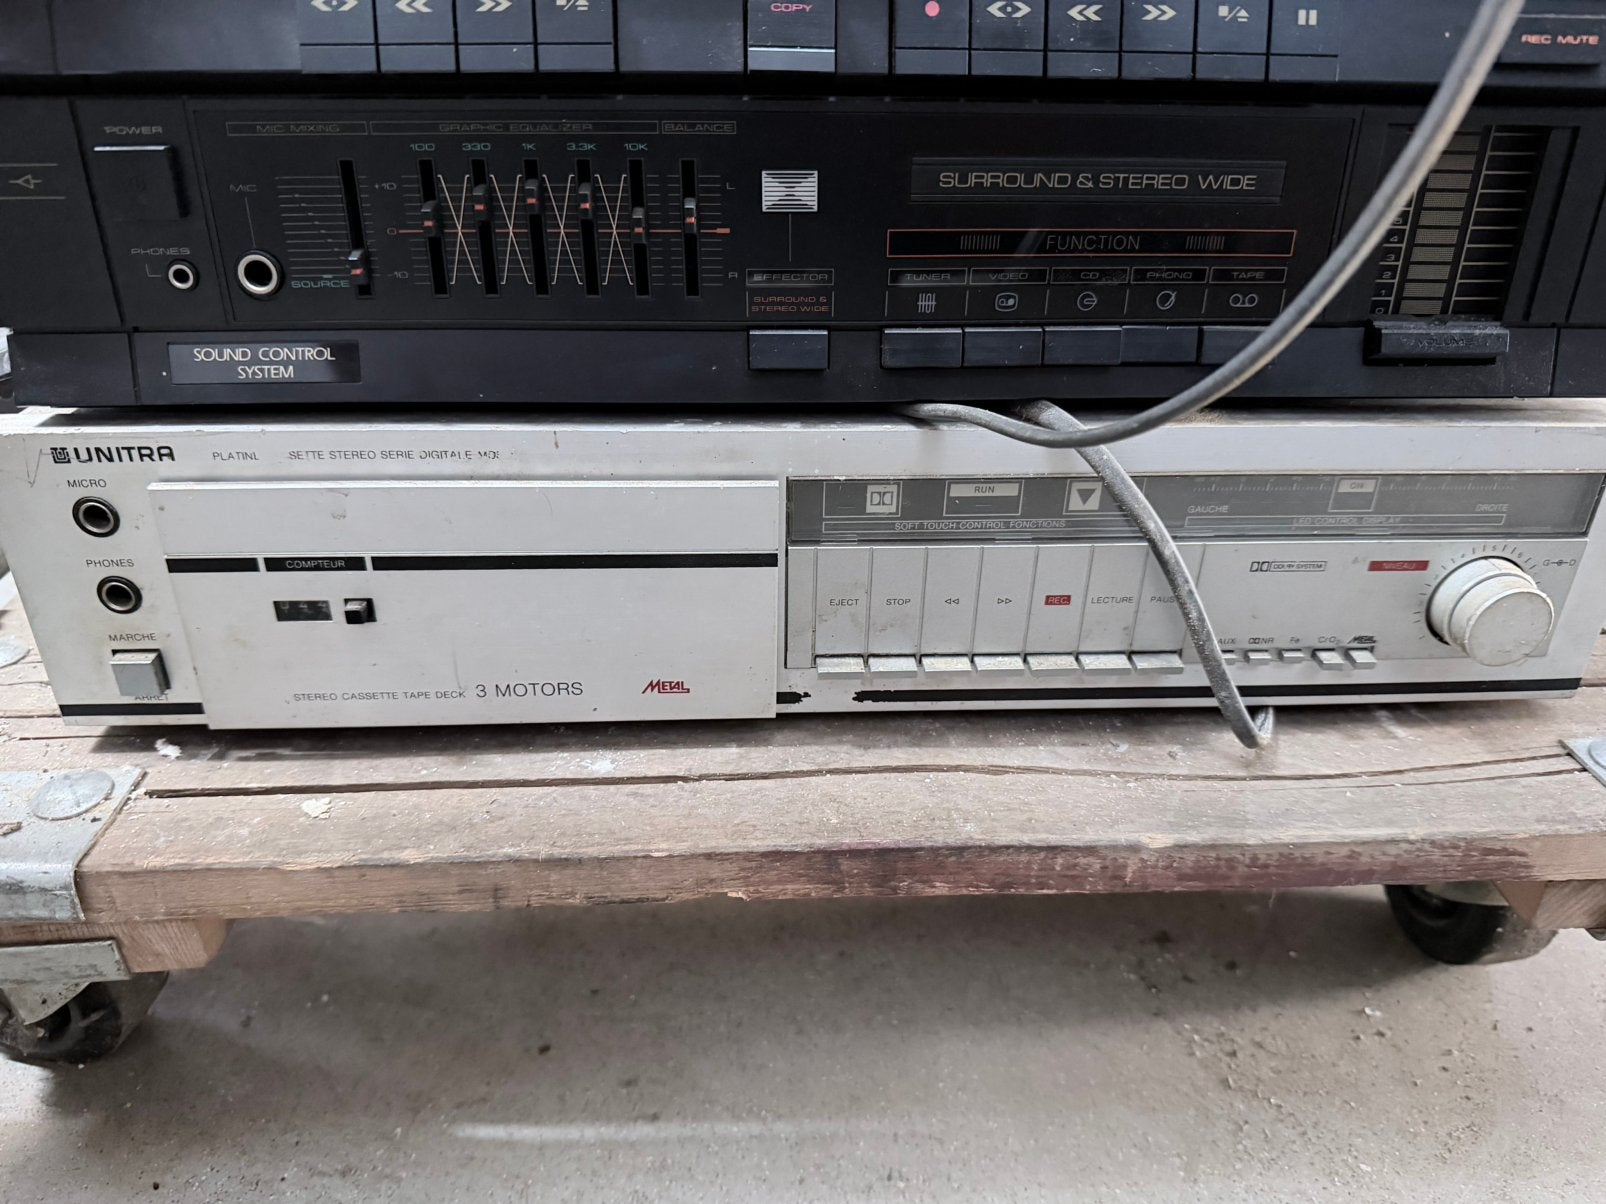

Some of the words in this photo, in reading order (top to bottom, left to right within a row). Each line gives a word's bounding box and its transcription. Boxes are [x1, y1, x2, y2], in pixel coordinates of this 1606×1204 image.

[771, 3, 814, 12] COPY
[1521, 34, 1552, 44] REC
[1556, 35, 1600, 45] MUTE
[104, 125, 163, 135] POWER
[256, 123, 284, 133] MIC
[290, 123, 340, 132] MIXING
[439, 124, 503, 132] GRAPHIC
[509, 124, 593, 132] EQUALIZER
[664, 124, 733, 132] BALANCE
[409, 143, 436, 151] 100
[462, 143, 491, 151] 330
[521, 143, 537, 151] 1K
[566, 143, 598, 151] 3.3K
[624, 143, 649, 151] 10K
[939, 172, 1071, 189] SURROUND
[1076, 173, 1094, 189] &
[1099, 173, 1189, 190] STEREO
[1198, 174, 1258, 190] WIDE
[229, 183, 257, 192] MIC
[374, 183, 397, 191] +10
[726, 182, 736, 190] L
[1046, 235, 1141, 251] FUNCTION
[130, 247, 190, 256] PHONES
[753, 273, 828, 281] EFFECTOR
[904, 273, 951, 281] TUNER
[988, 272, 1029, 280] VIDEO
[1080, 271, 1099, 279] CD
[1146, 271, 1193, 280] PHONO
[1231, 271, 1265, 279] TAPE
[1382, 271, 1392, 279] 2
[291, 279, 350, 289] SOURCE
[193, 347, 251, 362] SOUND
[259, 347, 336, 361] CONTROL
[237, 366, 294, 379] SYSTEM
[75, 446, 176, 463] UNITRA
[329, 450, 377, 460] STEREO
[380, 450, 415, 460] SERIE
[419, 450, 472, 460] DIGITALE
[67, 479, 107, 488] MICRO
[973, 485, 995, 494] RUN
[1187, 505, 1230, 513] GAUCHE
[1475, 503, 1509, 512] DROITE
[1293, 517, 1311, 525] LED
[1314, 517, 1359, 525] CONTROL
[1362, 517, 1401, 525] DISPLAY
[894, 522, 919, 531] SOFT
[923, 522, 956, 530] TOUCH
[959, 521, 1006, 530] CONTROL
[1010, 520, 1066, 529] FONCTIONS
[86, 558, 135, 568] PHONES
[286, 560, 346, 569] COMPTEUR
[1543, 559, 1550, 567] G
[829, 598, 860, 606] EJECT
[886, 598, 911, 606] STOP
[1091, 596, 1134, 604] LECTURE
[1150, 596, 1178, 604] PAUS
[109, 633, 157, 642] MARCHE
[1218, 637, 1237, 645] AUX
[641, 678, 691, 694] METAL
[293, 692, 338, 701] STEREO
[342, 692, 399, 701] CASSETTE
[402, 691, 431, 700] TAPE
[435, 690, 466, 699] DECK
[475, 683, 488, 699] 3
[495, 682, 584, 698] MOTORS
